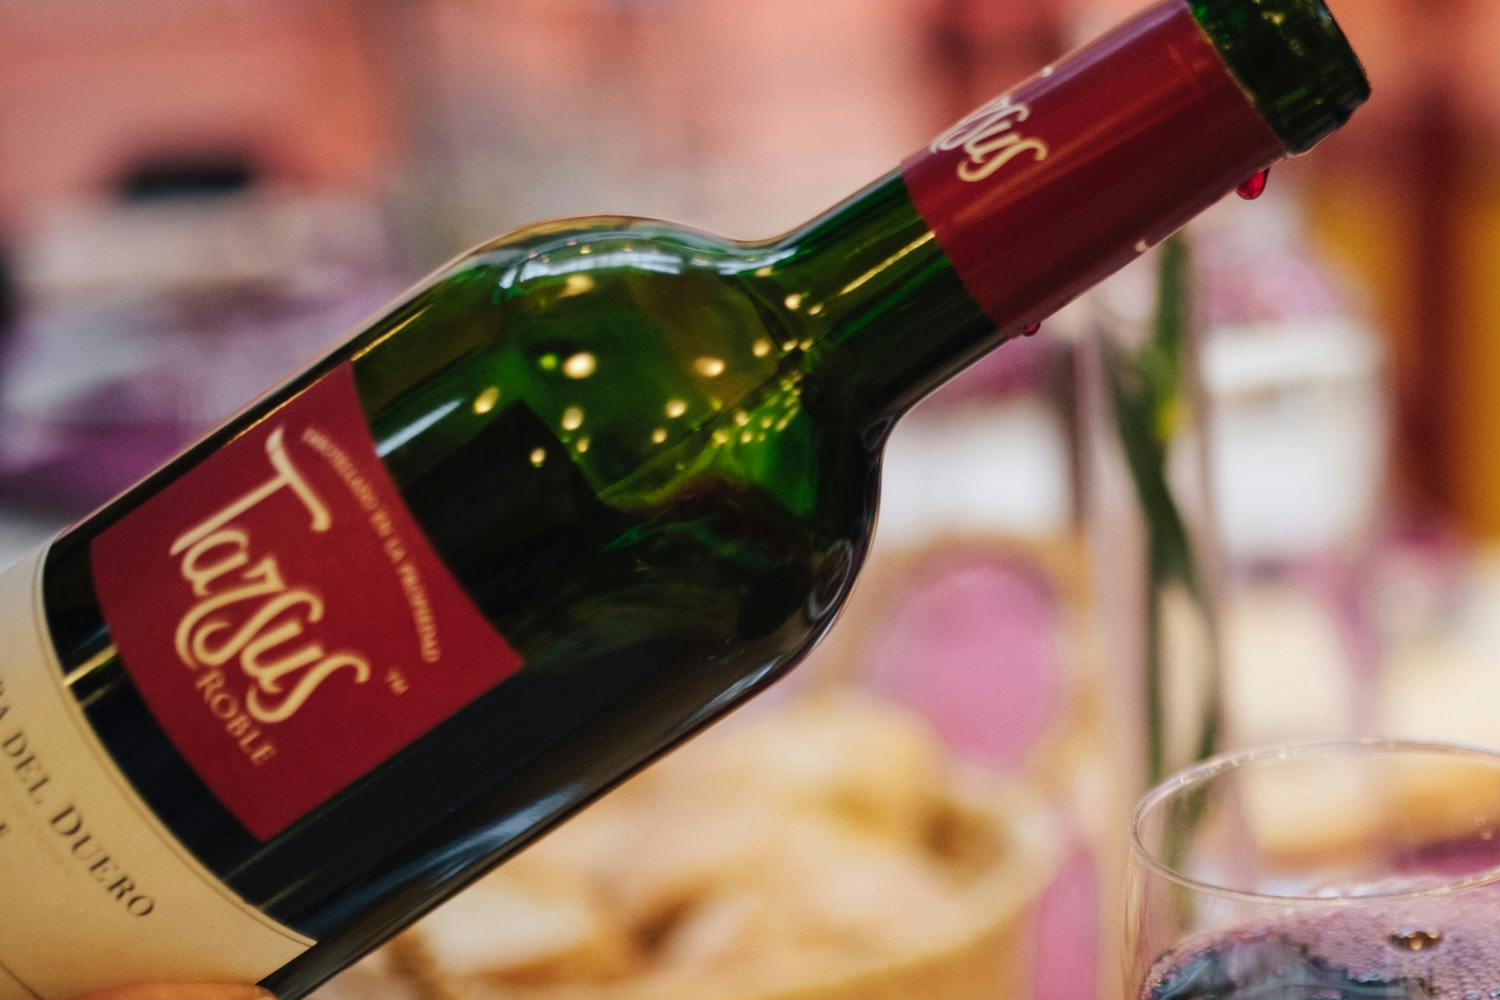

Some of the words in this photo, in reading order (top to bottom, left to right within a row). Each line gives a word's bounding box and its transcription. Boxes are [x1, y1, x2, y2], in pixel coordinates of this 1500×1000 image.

[195, 669, 277, 768] ROBLE
[2, 731, 50, 804] DEL
[51, 804, 155, 919] DUERO
